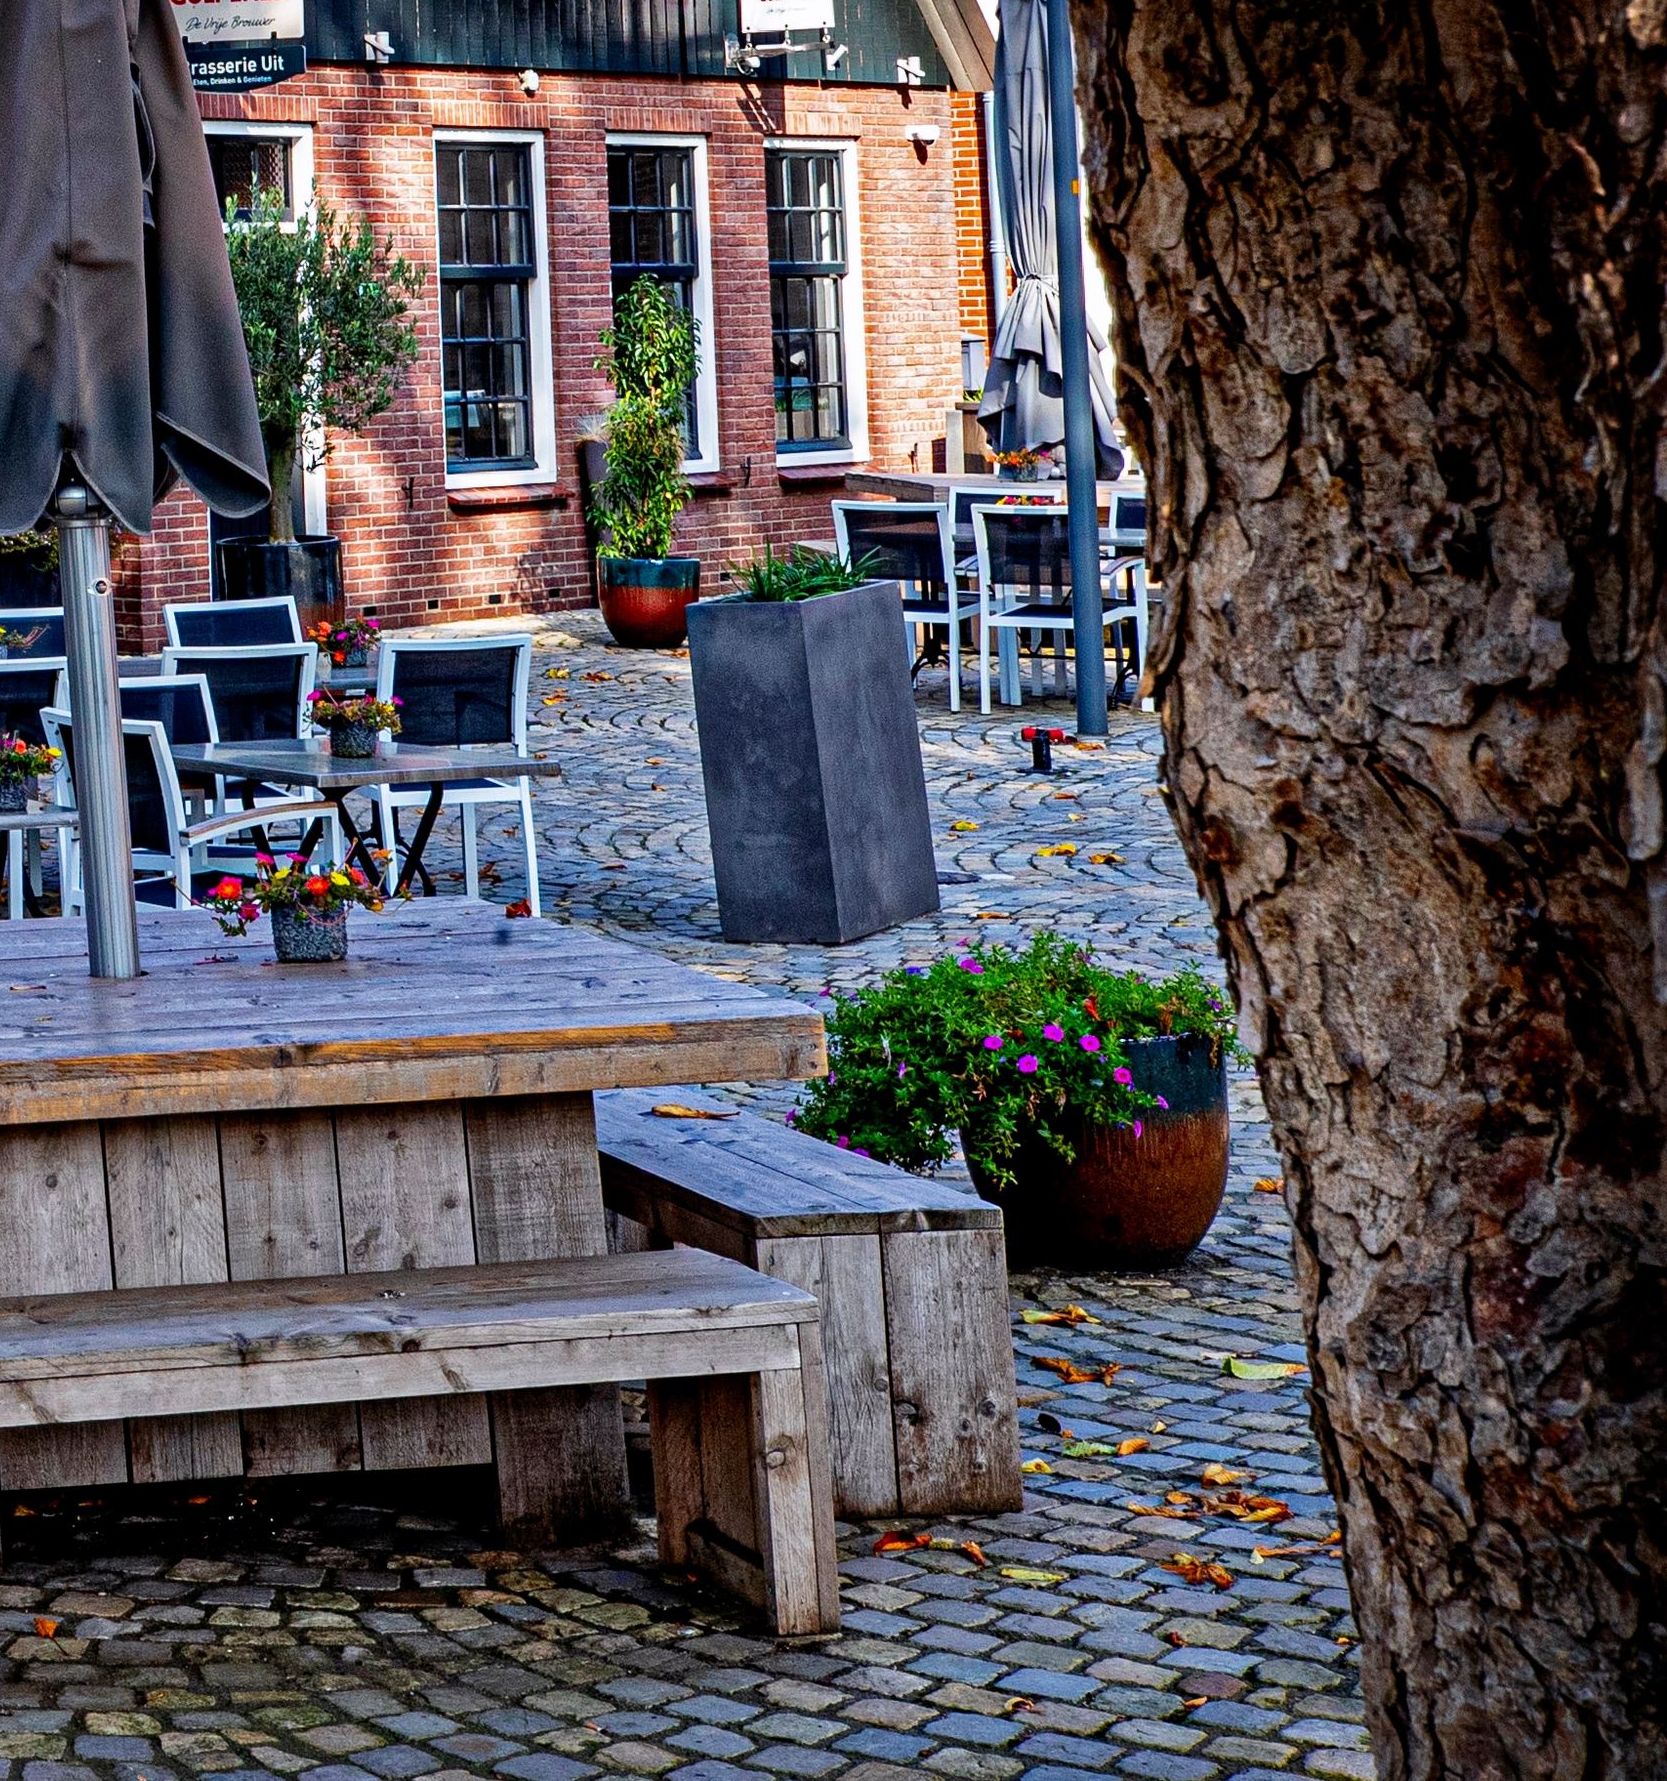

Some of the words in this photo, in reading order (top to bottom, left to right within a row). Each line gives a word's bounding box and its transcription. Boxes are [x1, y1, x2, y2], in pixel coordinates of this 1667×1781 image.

[185, 16, 202, 31] De
[230, 15, 276, 29] Brouwer
[187, 56, 258, 76] rasserie
[260, 54, 285, 72] Uit
